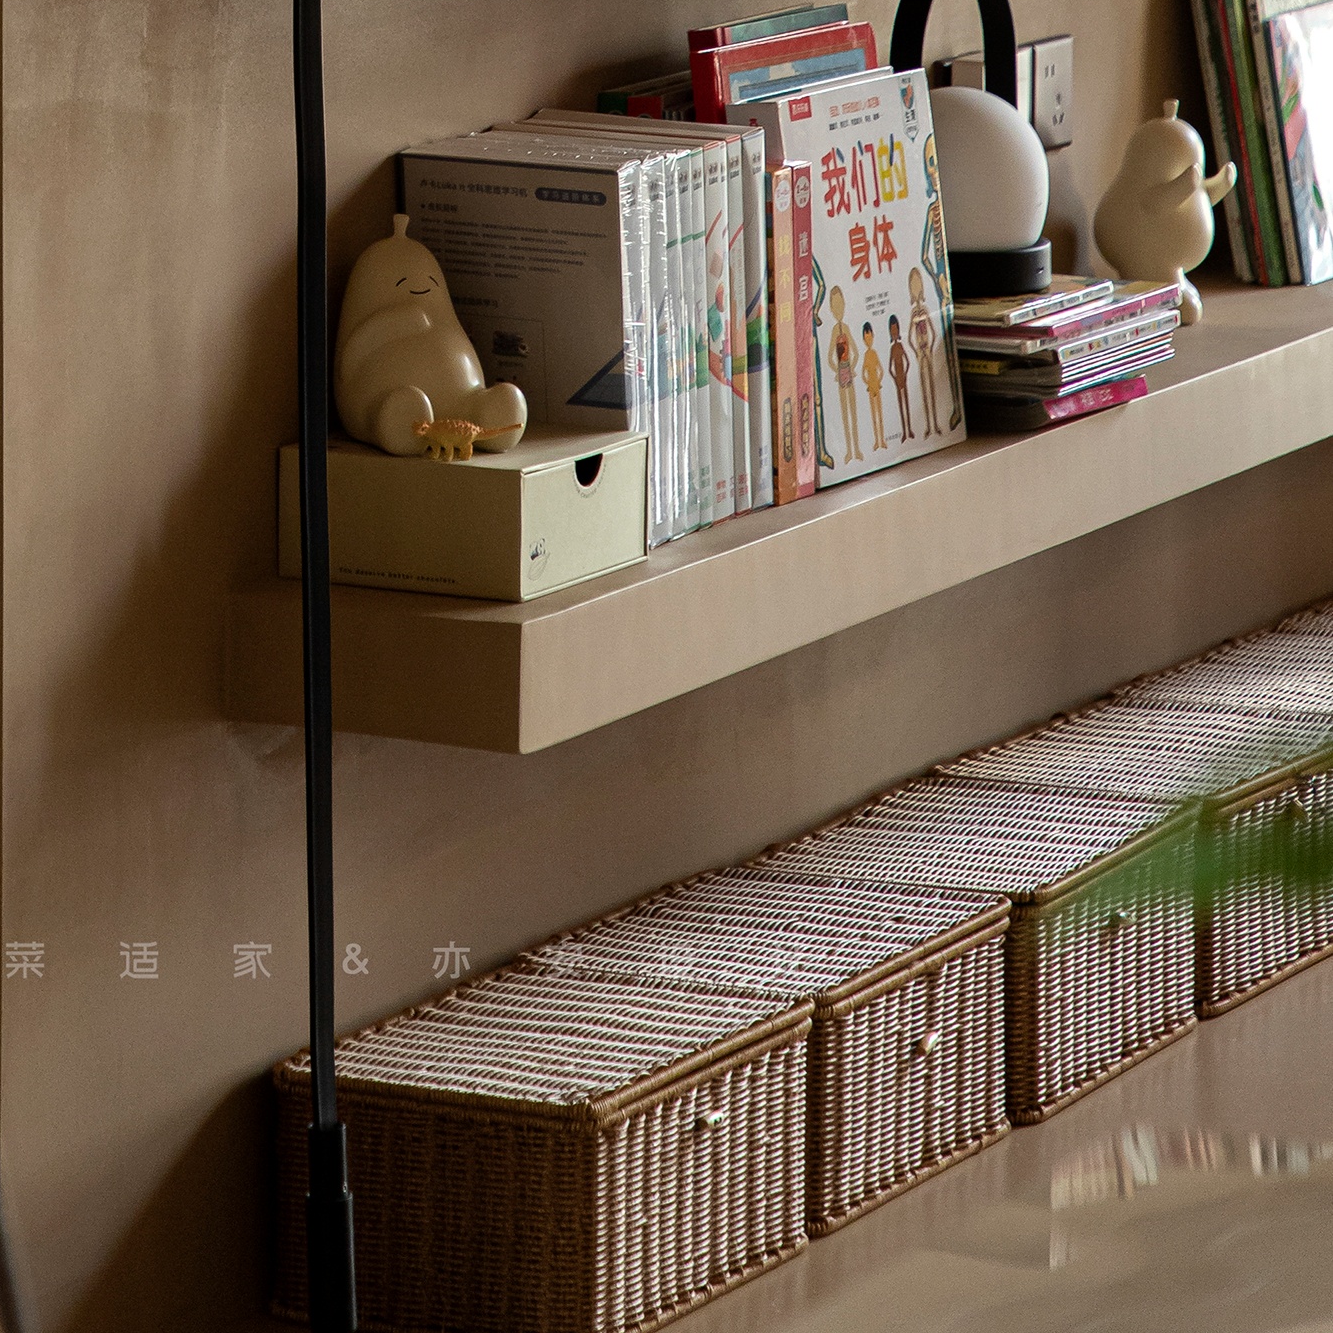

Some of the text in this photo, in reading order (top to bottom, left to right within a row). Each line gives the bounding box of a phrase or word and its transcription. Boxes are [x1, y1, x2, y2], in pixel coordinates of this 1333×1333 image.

[821, 133, 909, 219] 我们的
[778, 234, 793, 325] 找不同
[798, 231, 809, 302] 迷宫
[848, 214, 898, 282] 身体
